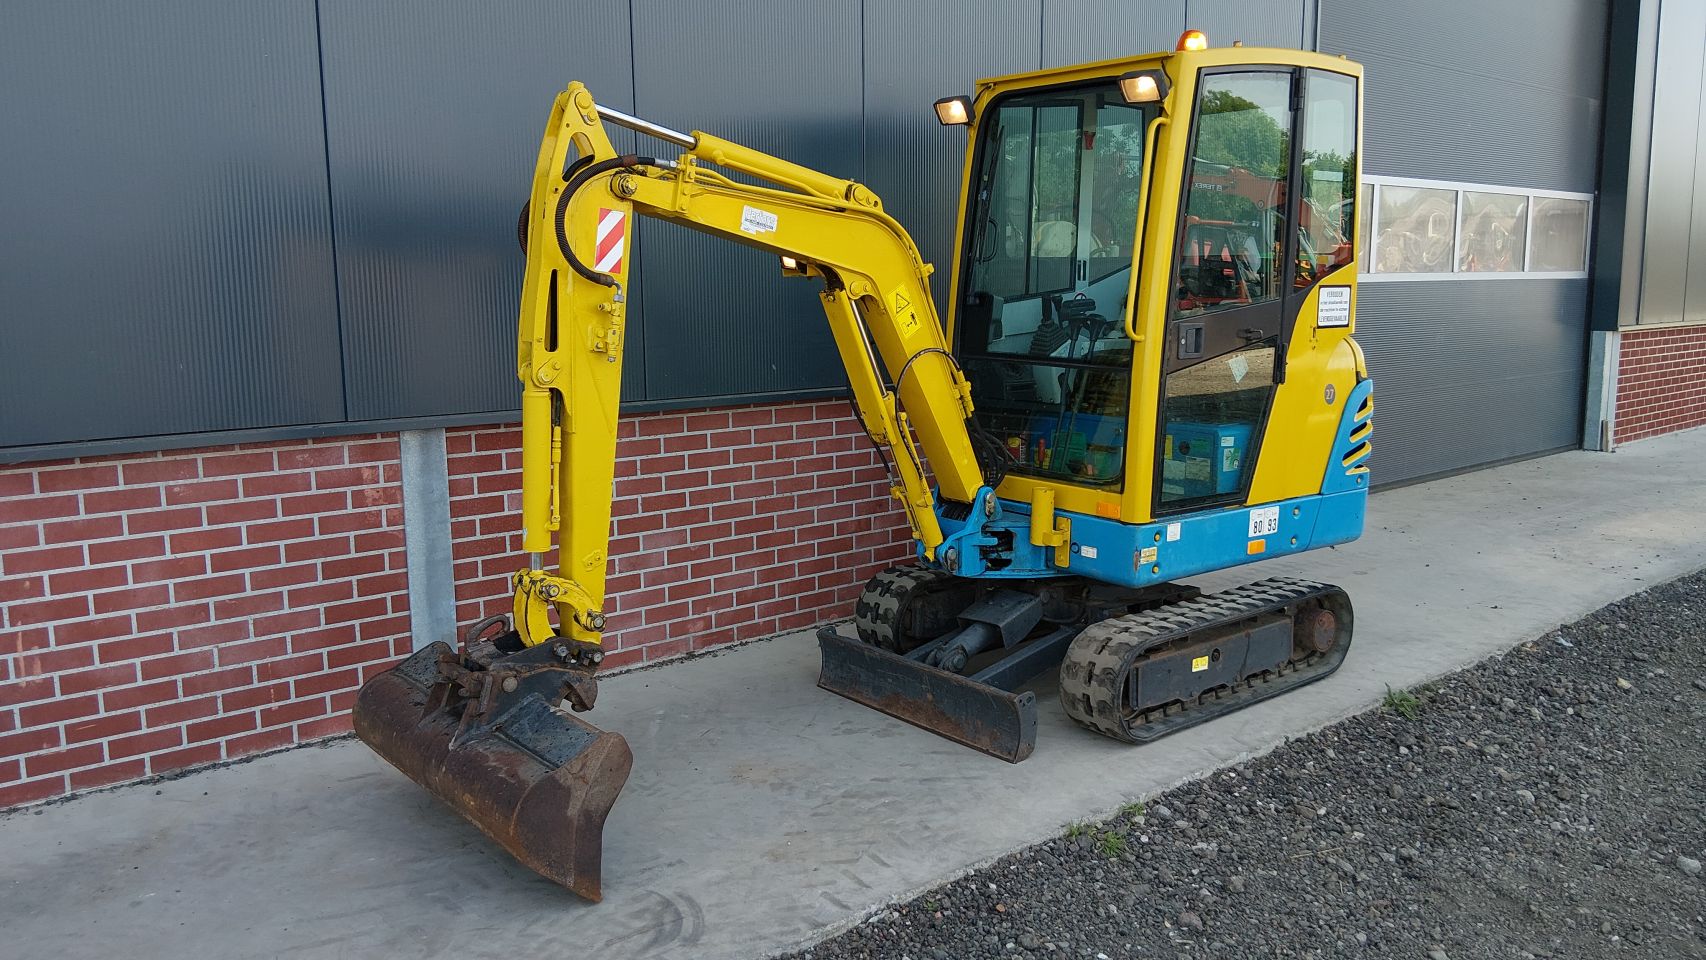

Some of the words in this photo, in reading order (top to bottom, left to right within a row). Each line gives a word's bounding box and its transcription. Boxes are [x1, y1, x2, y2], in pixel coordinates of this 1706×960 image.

[1325, 389, 1334, 400] 27
[1252, 520, 1263, 534] 80
[1267, 518, 1277, 531] 93
